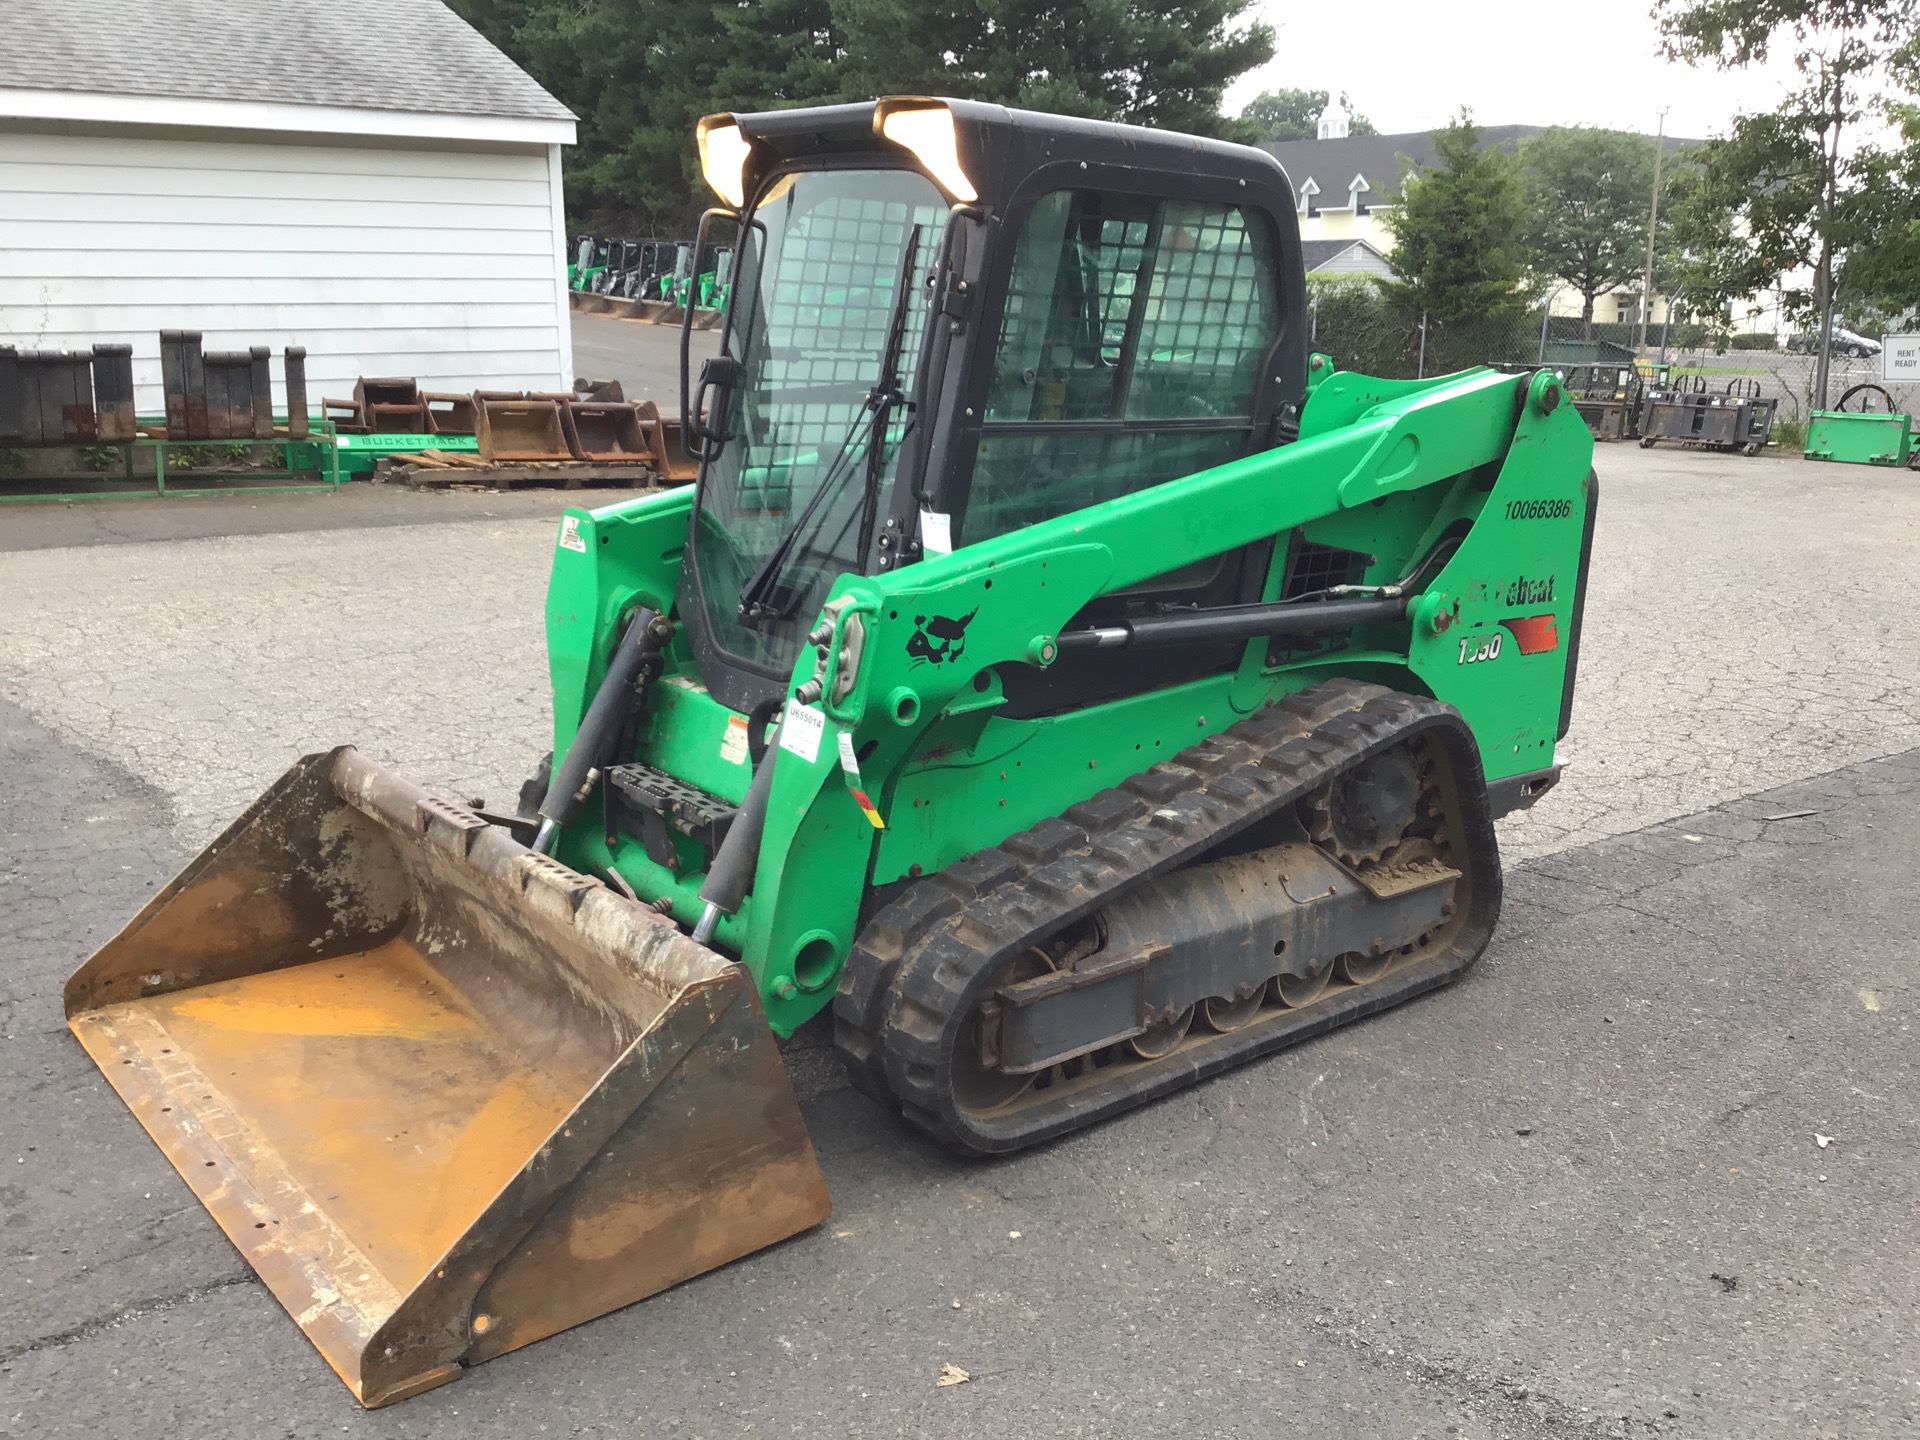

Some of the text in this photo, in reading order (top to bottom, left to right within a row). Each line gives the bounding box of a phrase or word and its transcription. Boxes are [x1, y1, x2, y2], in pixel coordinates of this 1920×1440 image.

[362, 437, 467, 445] BUCKET RACK
[1505, 499, 1572, 520] 10066386
[790, 706, 822, 728] U655014
